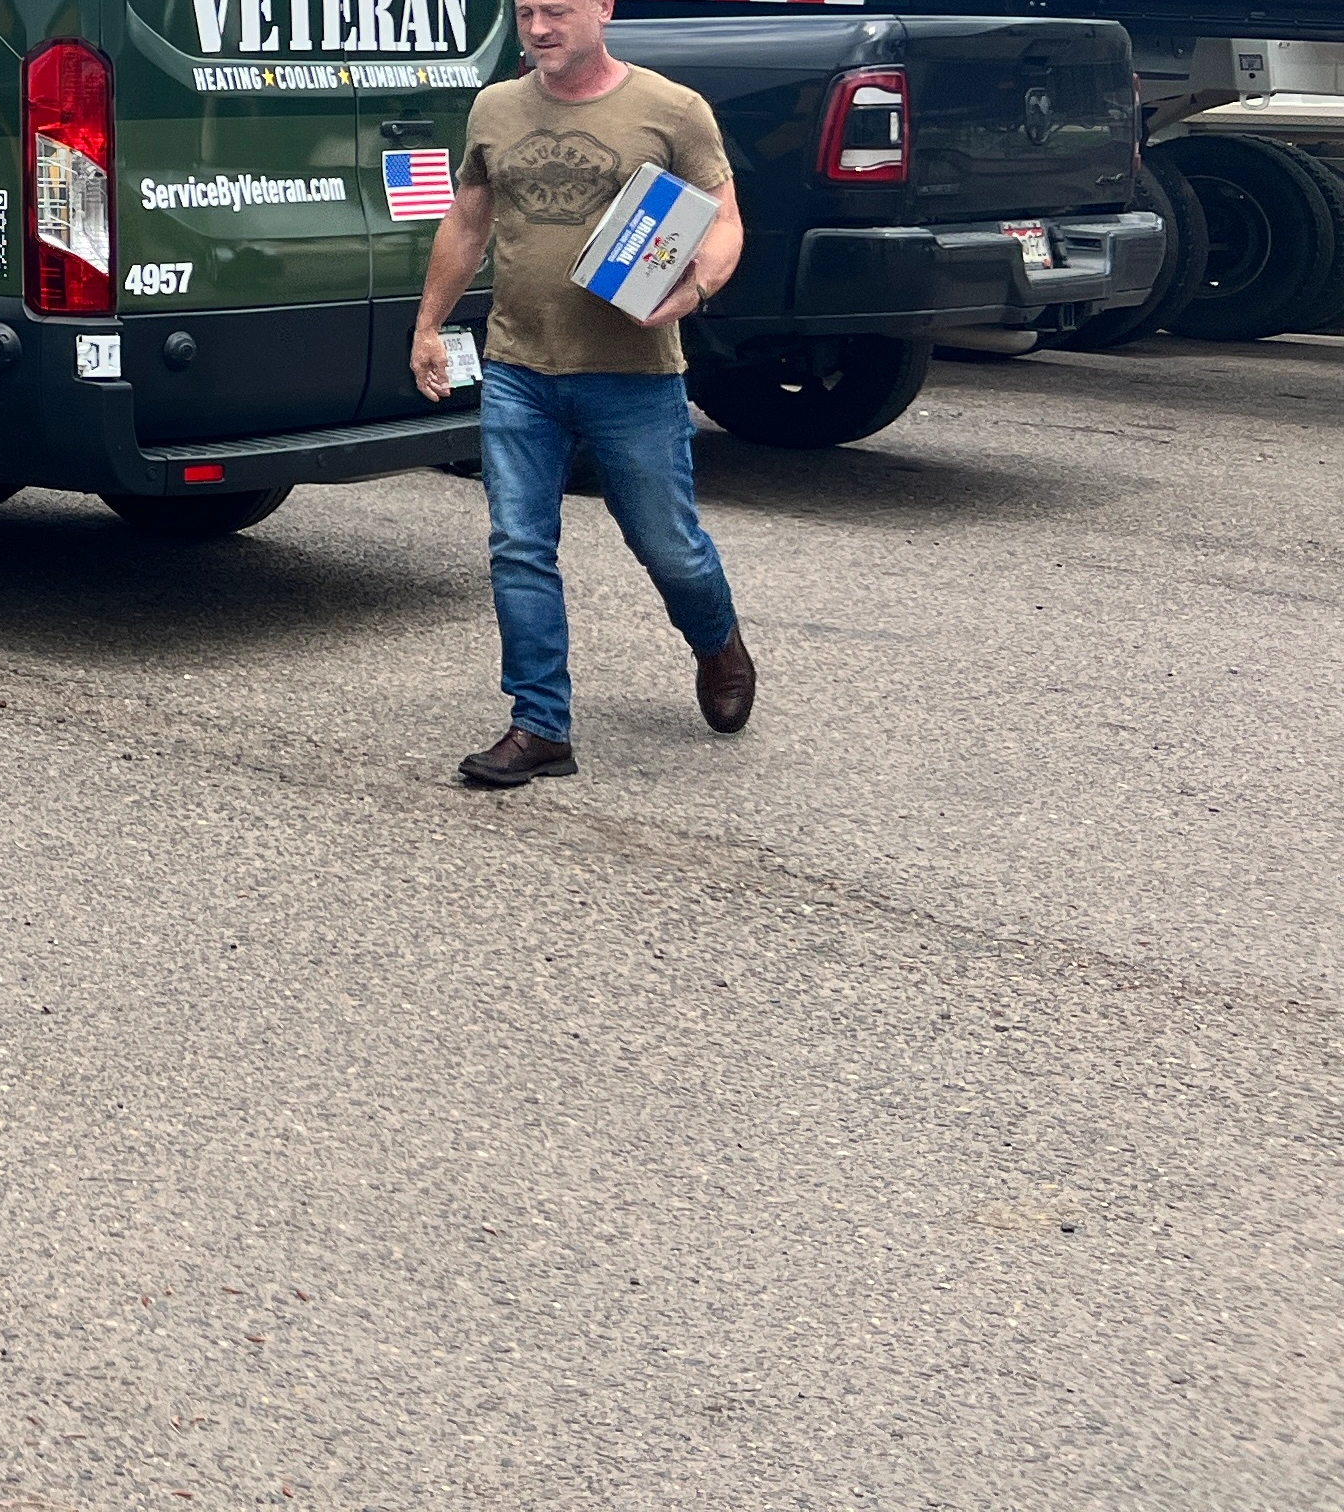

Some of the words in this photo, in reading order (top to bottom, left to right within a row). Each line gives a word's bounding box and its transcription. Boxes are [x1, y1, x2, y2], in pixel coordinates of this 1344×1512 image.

[192, 66, 262, 91] HEATING
[275, 65, 338, 90] COOLING
[349, 65, 417, 89] PLUMBING
[426, 65, 483, 88] ELECTRIC
[140, 174, 348, 212] ServiceByVeteran.com
[616, 215, 657, 266] ORIGINAL
[124, 263, 193, 295] 4957
[444, 338, 463, 351] 305
